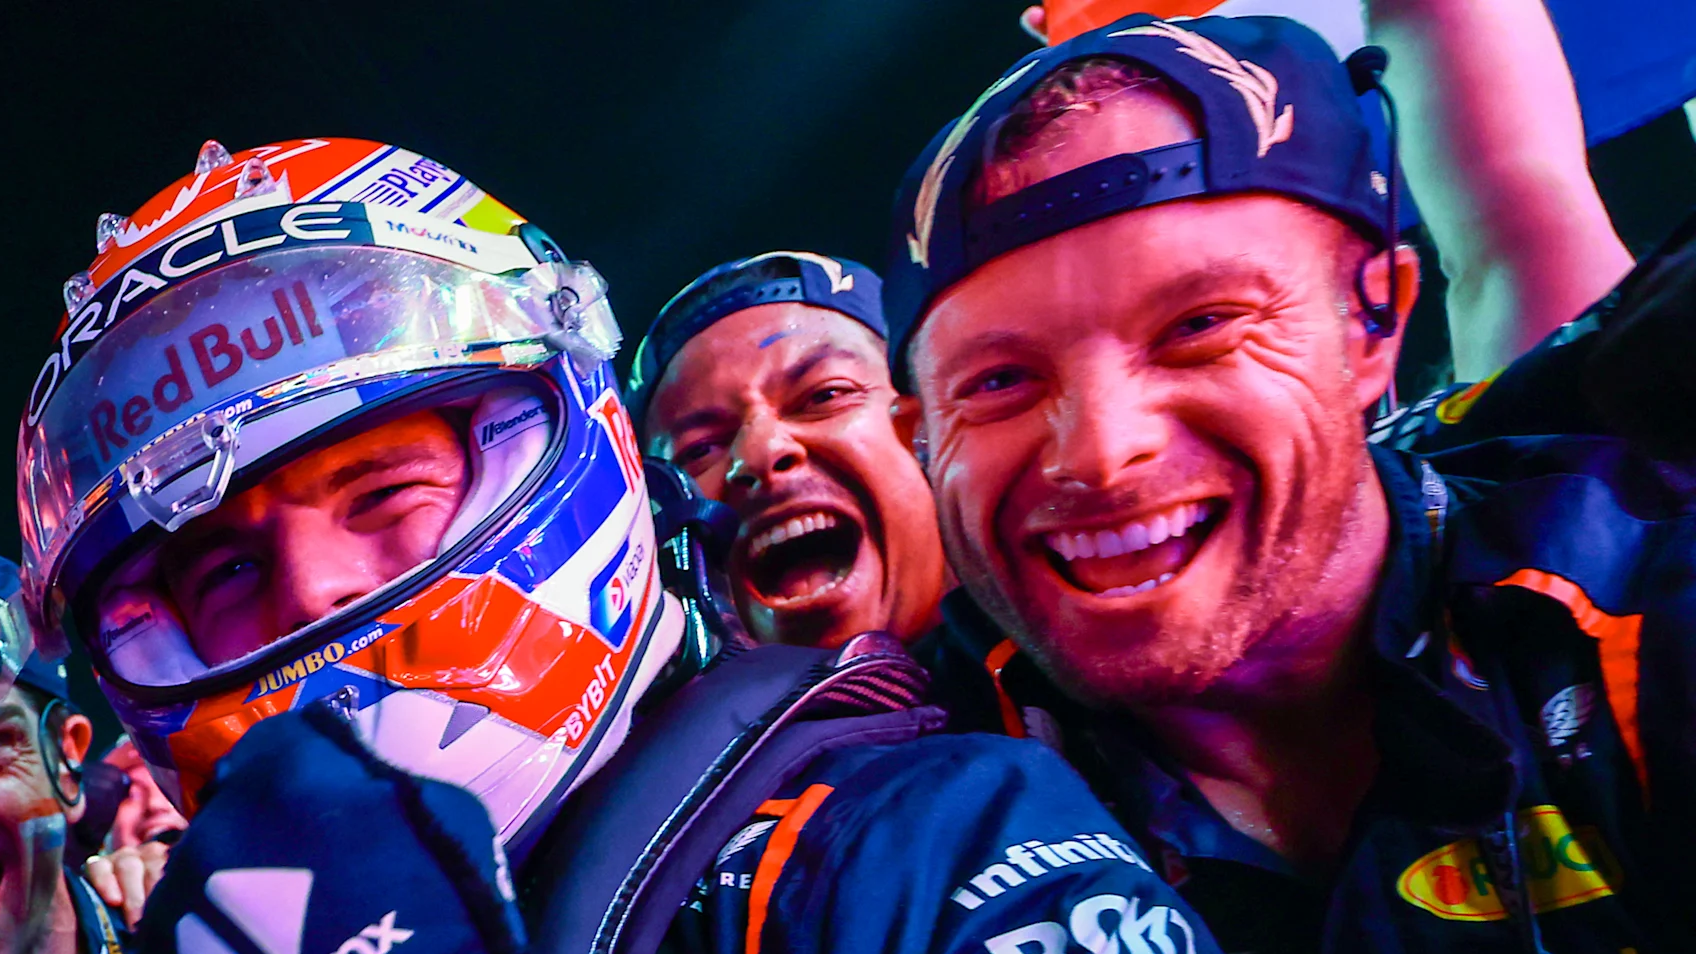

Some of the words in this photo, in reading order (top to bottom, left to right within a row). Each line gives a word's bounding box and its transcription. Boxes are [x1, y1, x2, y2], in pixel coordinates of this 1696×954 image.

[28, 203, 350, 426] ORACLE
[86, 344, 194, 462] Red
[188, 280, 324, 389] Bull
[259, 626, 384, 697] JUMBO.com
[564, 653, 617, 742] BYBIT
